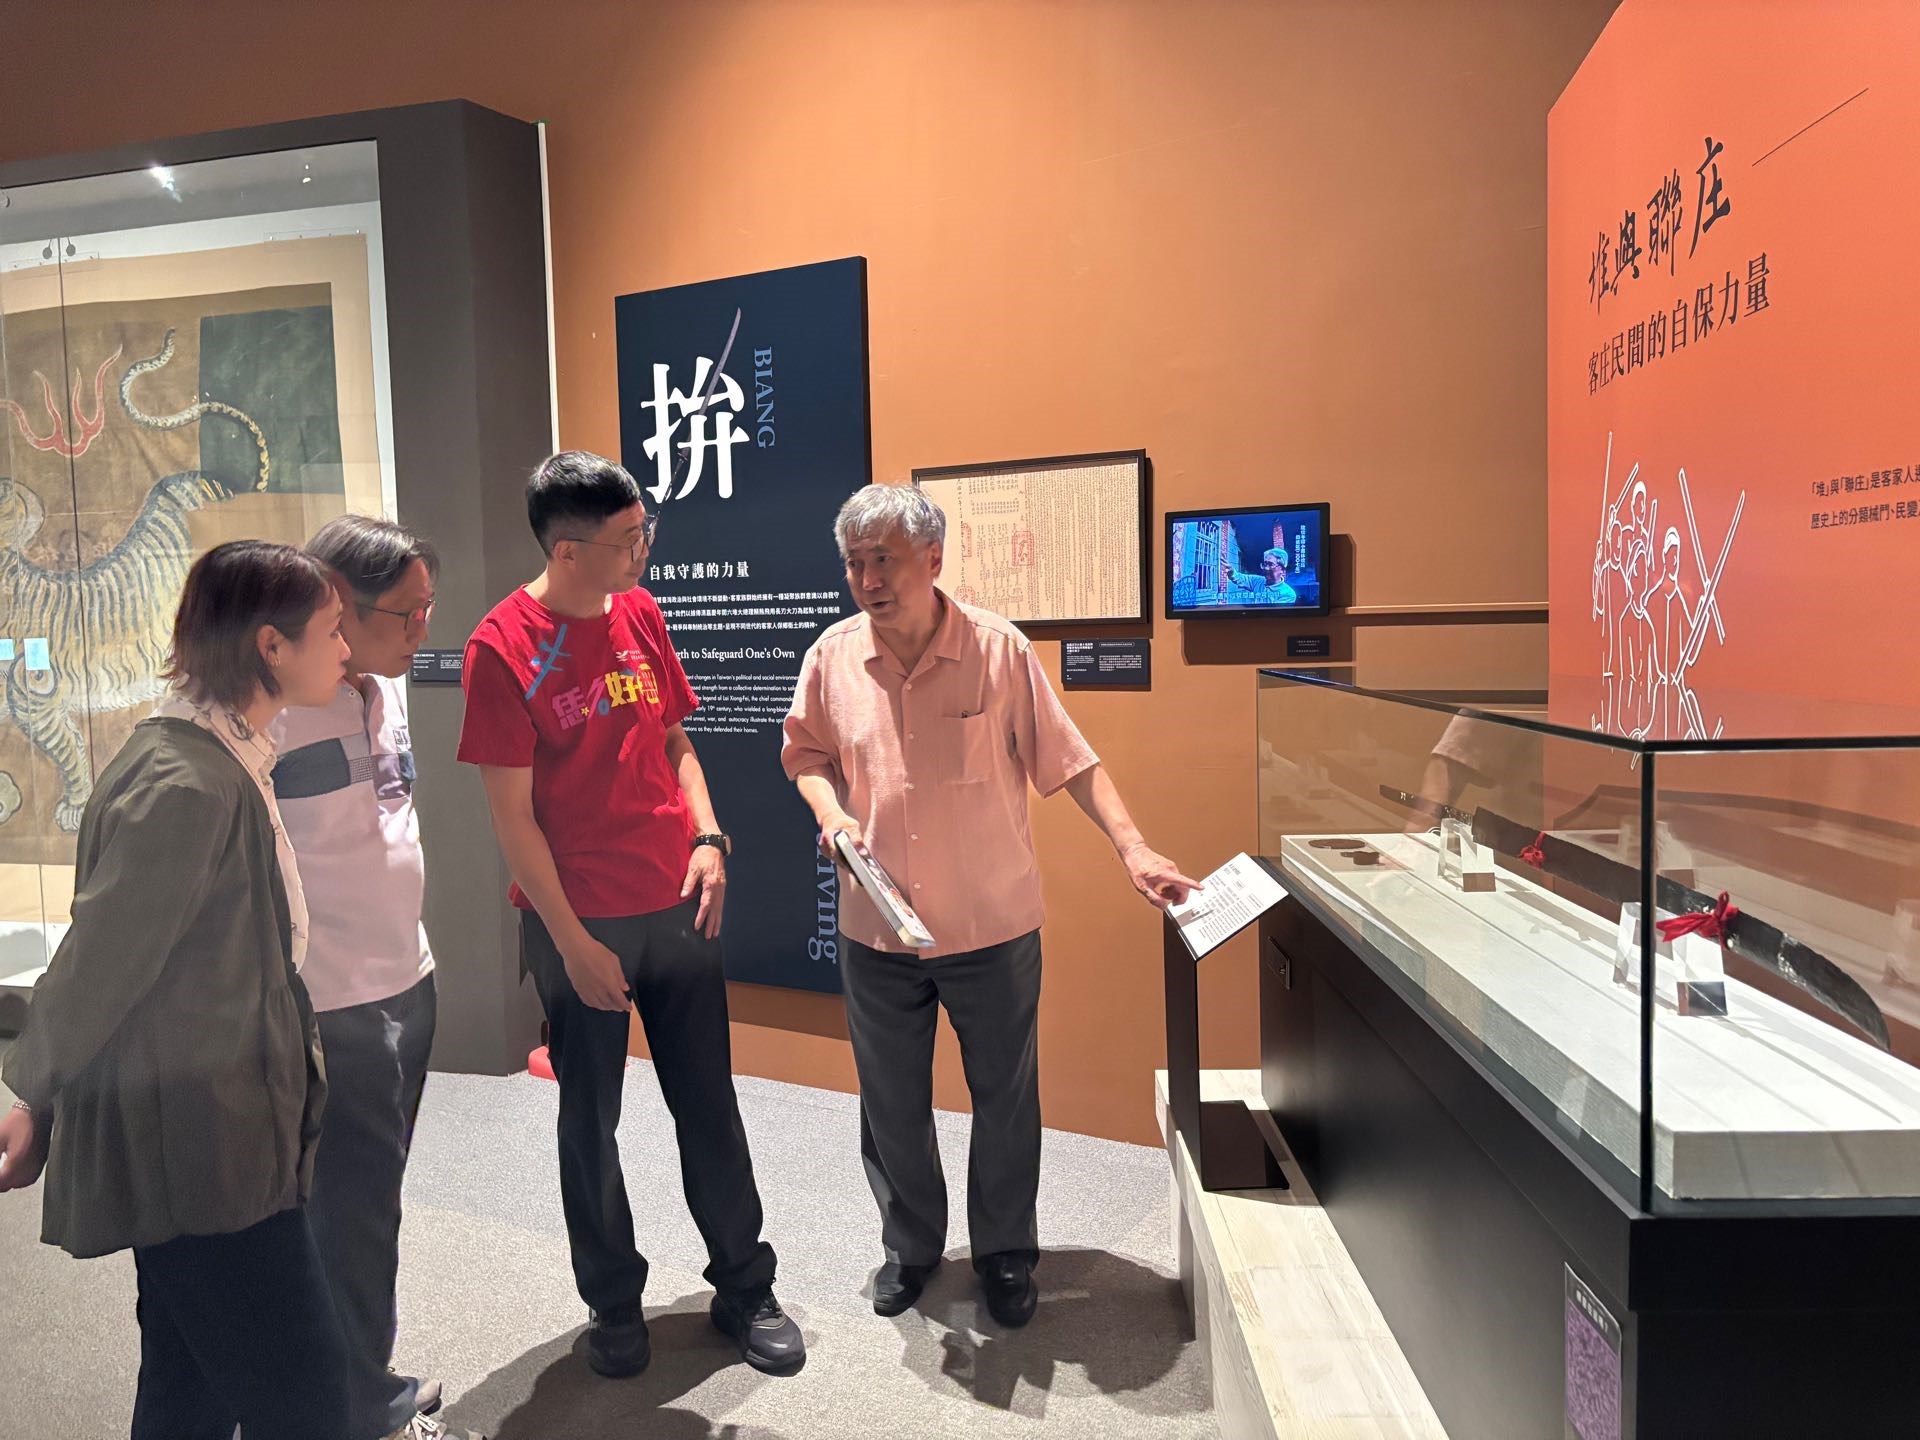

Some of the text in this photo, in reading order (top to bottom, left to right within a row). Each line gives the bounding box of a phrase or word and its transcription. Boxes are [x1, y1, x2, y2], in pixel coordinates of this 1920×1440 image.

[1589, 136, 1731, 314] 堆與聯庄
[1588, 252, 1771, 396] 客庄民間的自保力量
[754, 346, 776, 449] BIANG
[1811, 500, 1920, 529] 歷史上的分類械鬥、民變
[650, 560, 750, 581] 自我守護的力量
[675, 647, 795, 662] gth to Safeguard One's Own
[694, 674, 711, 682] changes
[717, 673, 736, 681] Taiwan's
[736, 673, 752, 682] political
[702, 684, 718, 692] strength
[753, 684, 782, 692] determination
[703, 695, 717, 703] legend
[759, 694, 769, 702] chief
[704, 726, 713, 734] they
